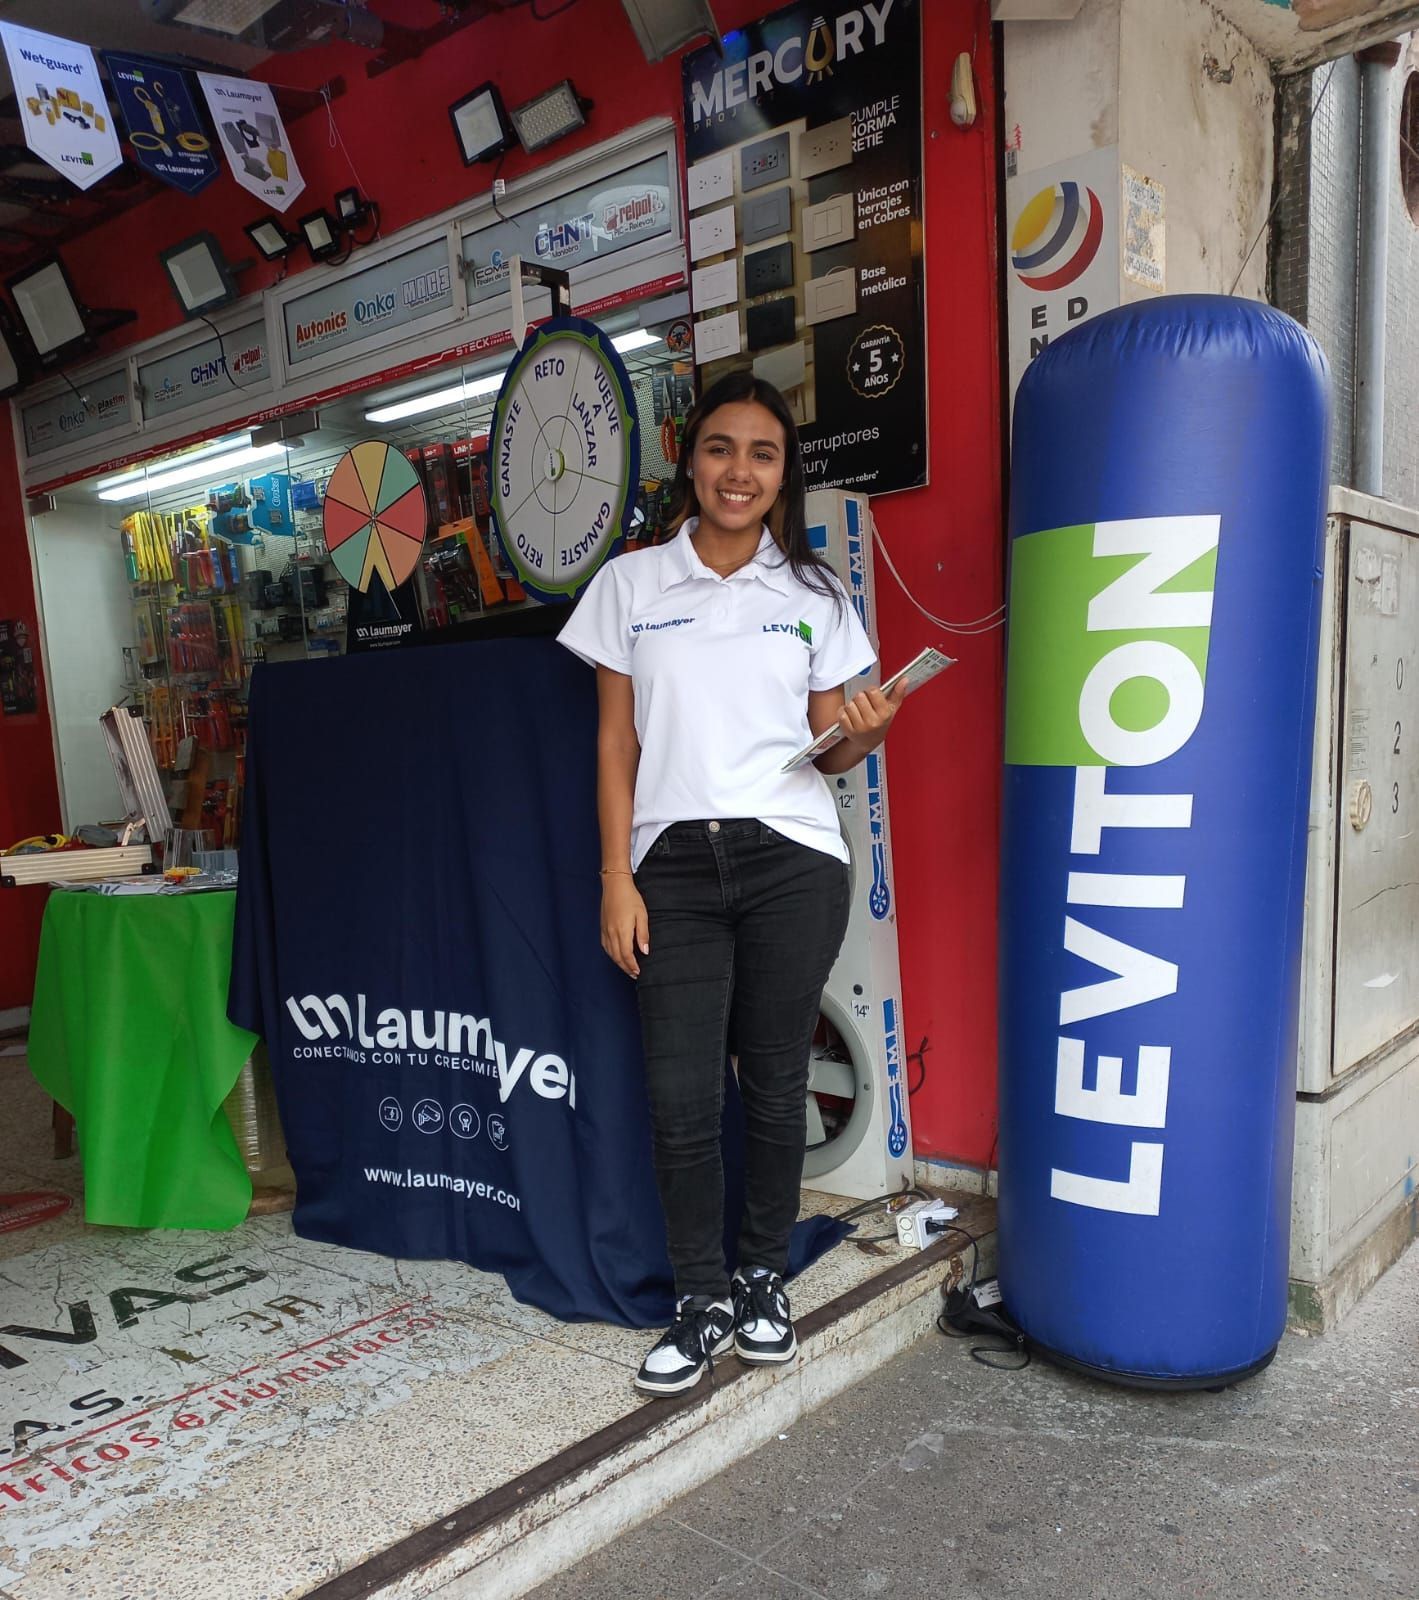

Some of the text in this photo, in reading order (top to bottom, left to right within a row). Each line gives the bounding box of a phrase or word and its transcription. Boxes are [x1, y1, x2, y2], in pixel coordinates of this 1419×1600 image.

[692, 0, 894, 123] MERCURY
[61, 153, 94, 166] LEVITON
[858, 179, 909, 204] Única con
[858, 195, 902, 217] herrajes
[858, 206, 911, 230] en Cobres
[476, 260, 511, 279] COME
[861, 264, 886, 281] Base
[861, 276, 907, 297] metálica
[297, 311, 347, 343] Autonics
[456, 337, 490, 356] STECK
[534, 358, 565, 382] RETO
[869, 349, 883, 373] 5
[864, 374, 889, 388] AÑOS
[593, 404, 602, 418] A
[594, 364, 620, 436] VUELVE
[258, 406, 285, 421] STECK
[572, 393, 597, 468] LANZAR
[799, 426, 880, 455] terruptores
[502, 400, 522, 498] GANASTE
[809, 479, 844, 492] conductor
[845, 476, 855, 485] en
[561, 501, 611, 567] GANASTE
[517, 533, 543, 568] RETO
[370, 622, 413, 639] Laumayer
[645, 617, 696, 631] Laumayer
[763, 623, 812, 646] LEVITON
[1051, 514, 1222, 1217] LEVITON
[854, 1004, 870, 1018] 14"
[372, 1052, 401, 1066] CON
[407, 1053, 428, 1066] TU
[435, 1054, 499, 1079] CRECIMIE
[364, 1167, 520, 1212] www.laumayer.co
[0, 1254, 267, 1370] VAS
[0, 1431, 161, 1512] tricos
